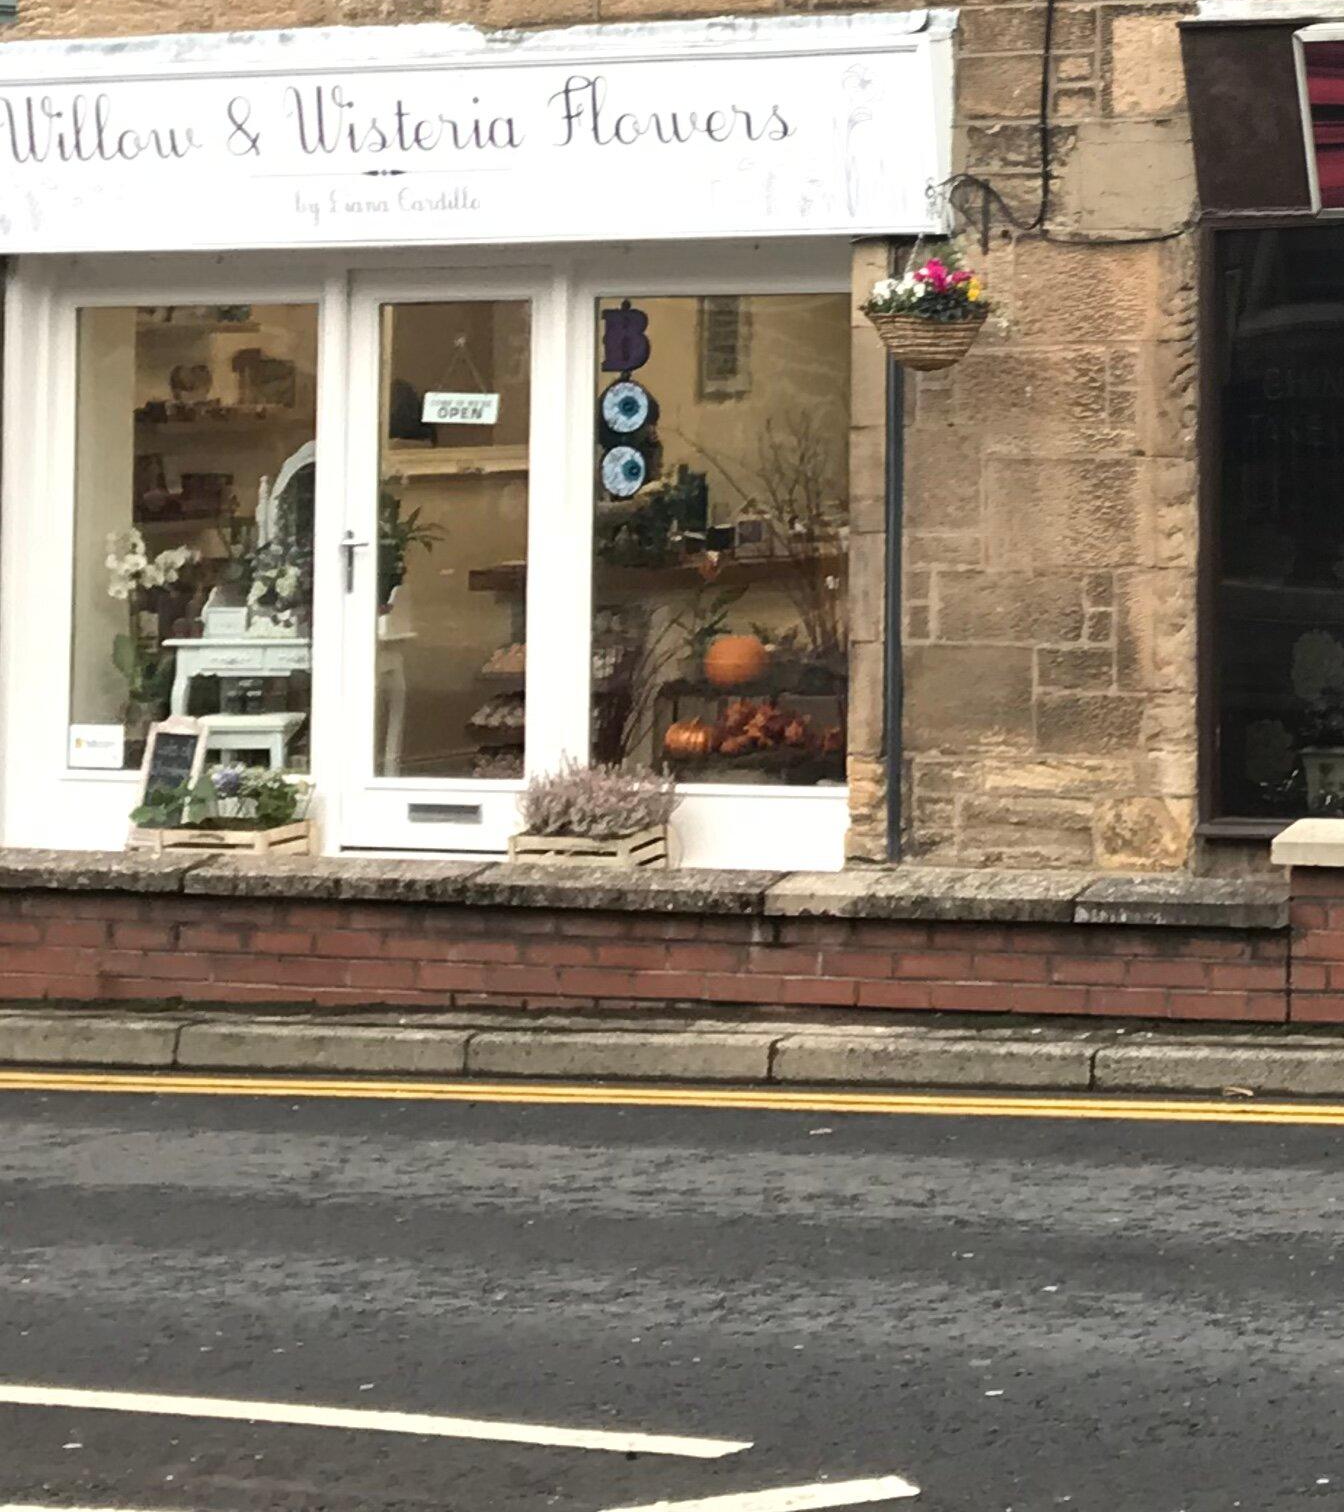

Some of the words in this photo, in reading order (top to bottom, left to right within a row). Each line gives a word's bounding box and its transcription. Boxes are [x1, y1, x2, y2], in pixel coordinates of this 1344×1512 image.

[0, 93, 202, 163] Willow
[226, 95, 262, 157] &
[283, 85, 525, 155] Wisteria
[547, 74, 798, 147] Flowers
[437, 407, 483, 419] OPEN
